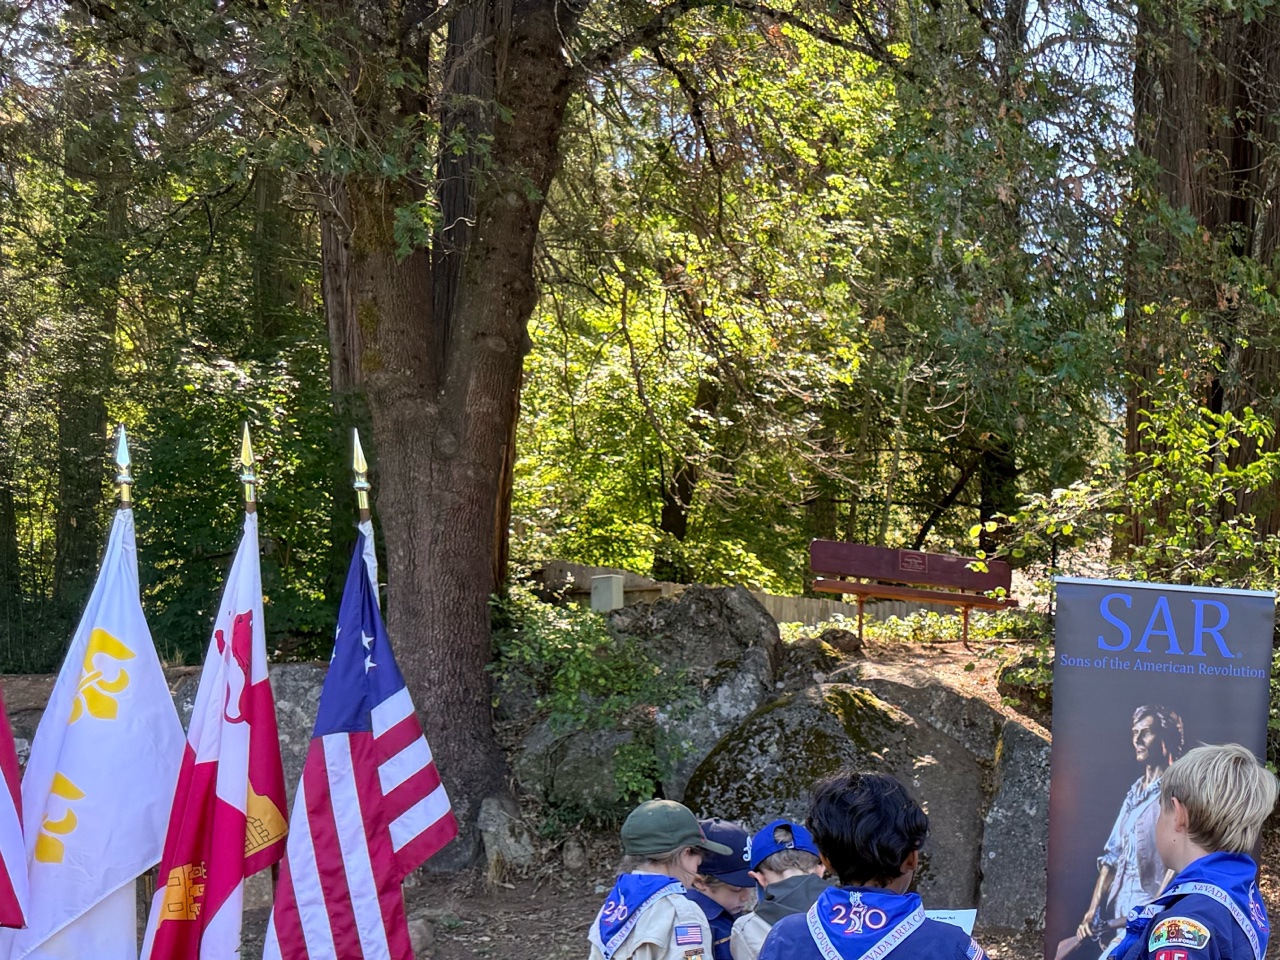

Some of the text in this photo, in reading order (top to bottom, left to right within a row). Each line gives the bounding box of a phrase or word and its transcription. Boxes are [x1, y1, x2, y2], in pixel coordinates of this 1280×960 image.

[1097, 592, 1235, 659] SAR
[1060, 654, 1266, 679] Sons of the American Revolution
[830, 904, 887, 935] 250
[891, 920, 915, 943] AREA
